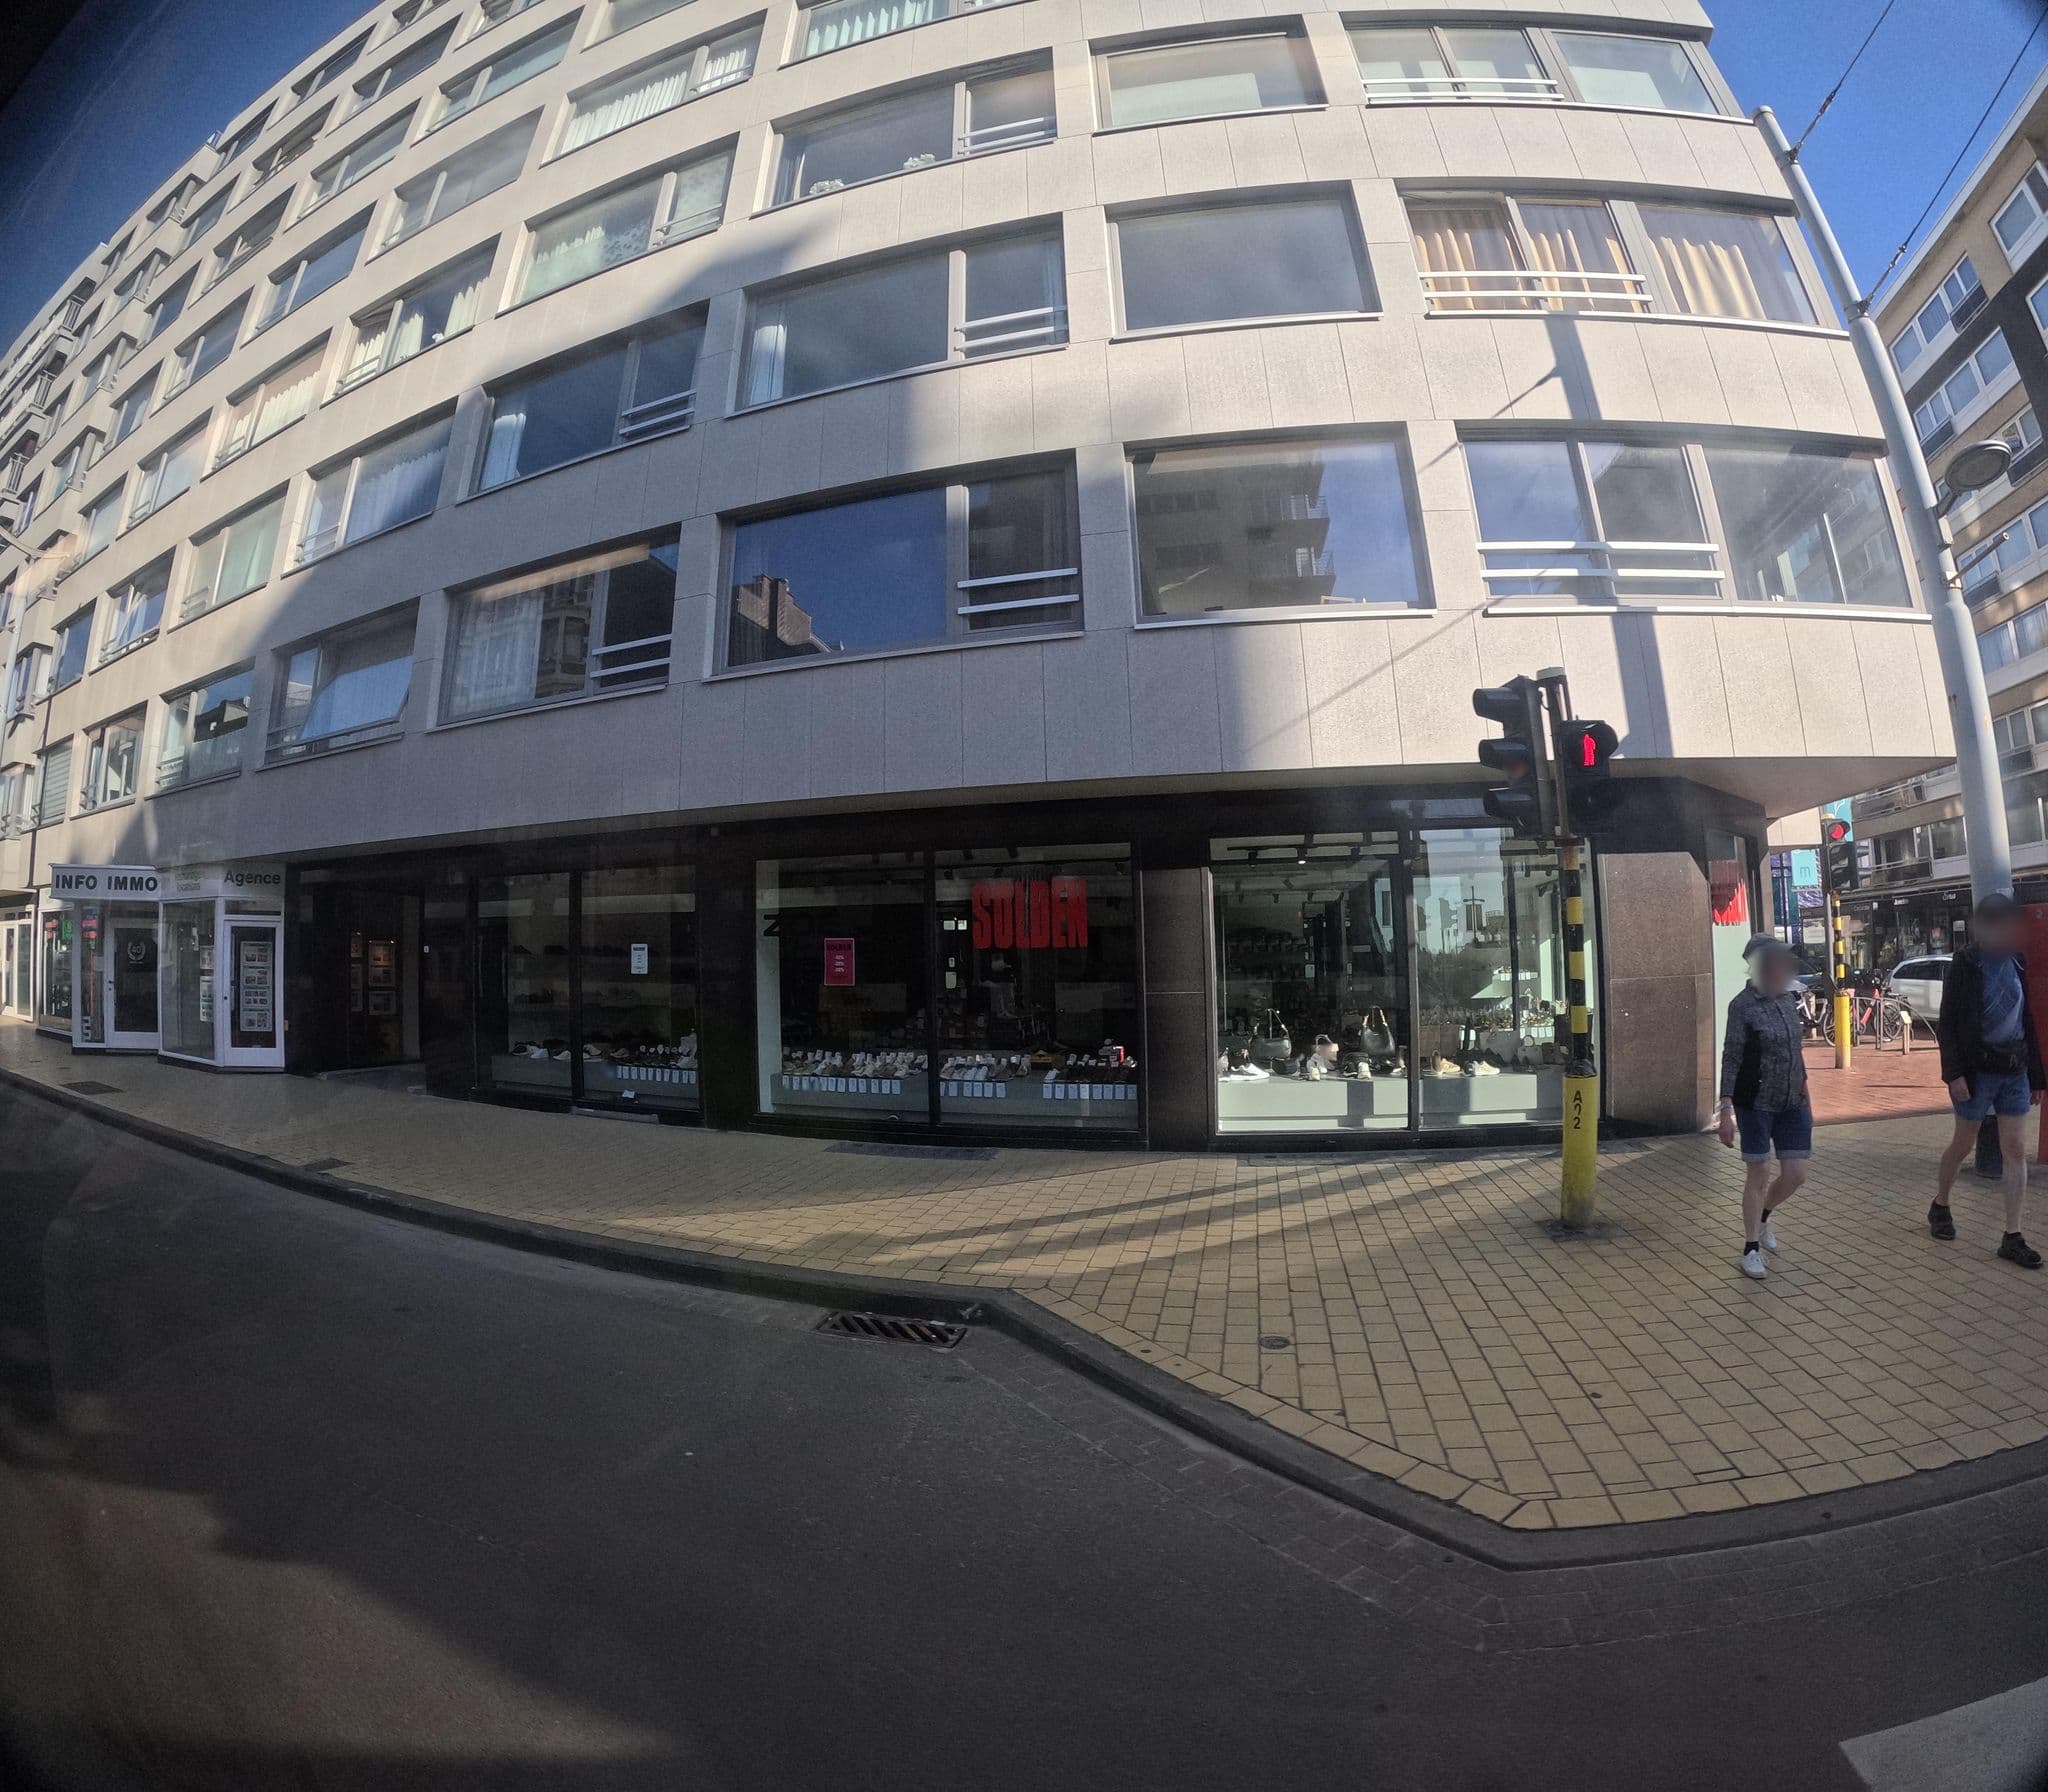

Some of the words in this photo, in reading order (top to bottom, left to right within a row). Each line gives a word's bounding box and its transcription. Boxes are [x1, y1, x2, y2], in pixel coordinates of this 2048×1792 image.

[56, 874, 98, 890] INFO
[107, 876, 158, 892] IMMO
[224, 870, 281, 887] Agence
[972, 877, 1088, 948] SOLDEN
